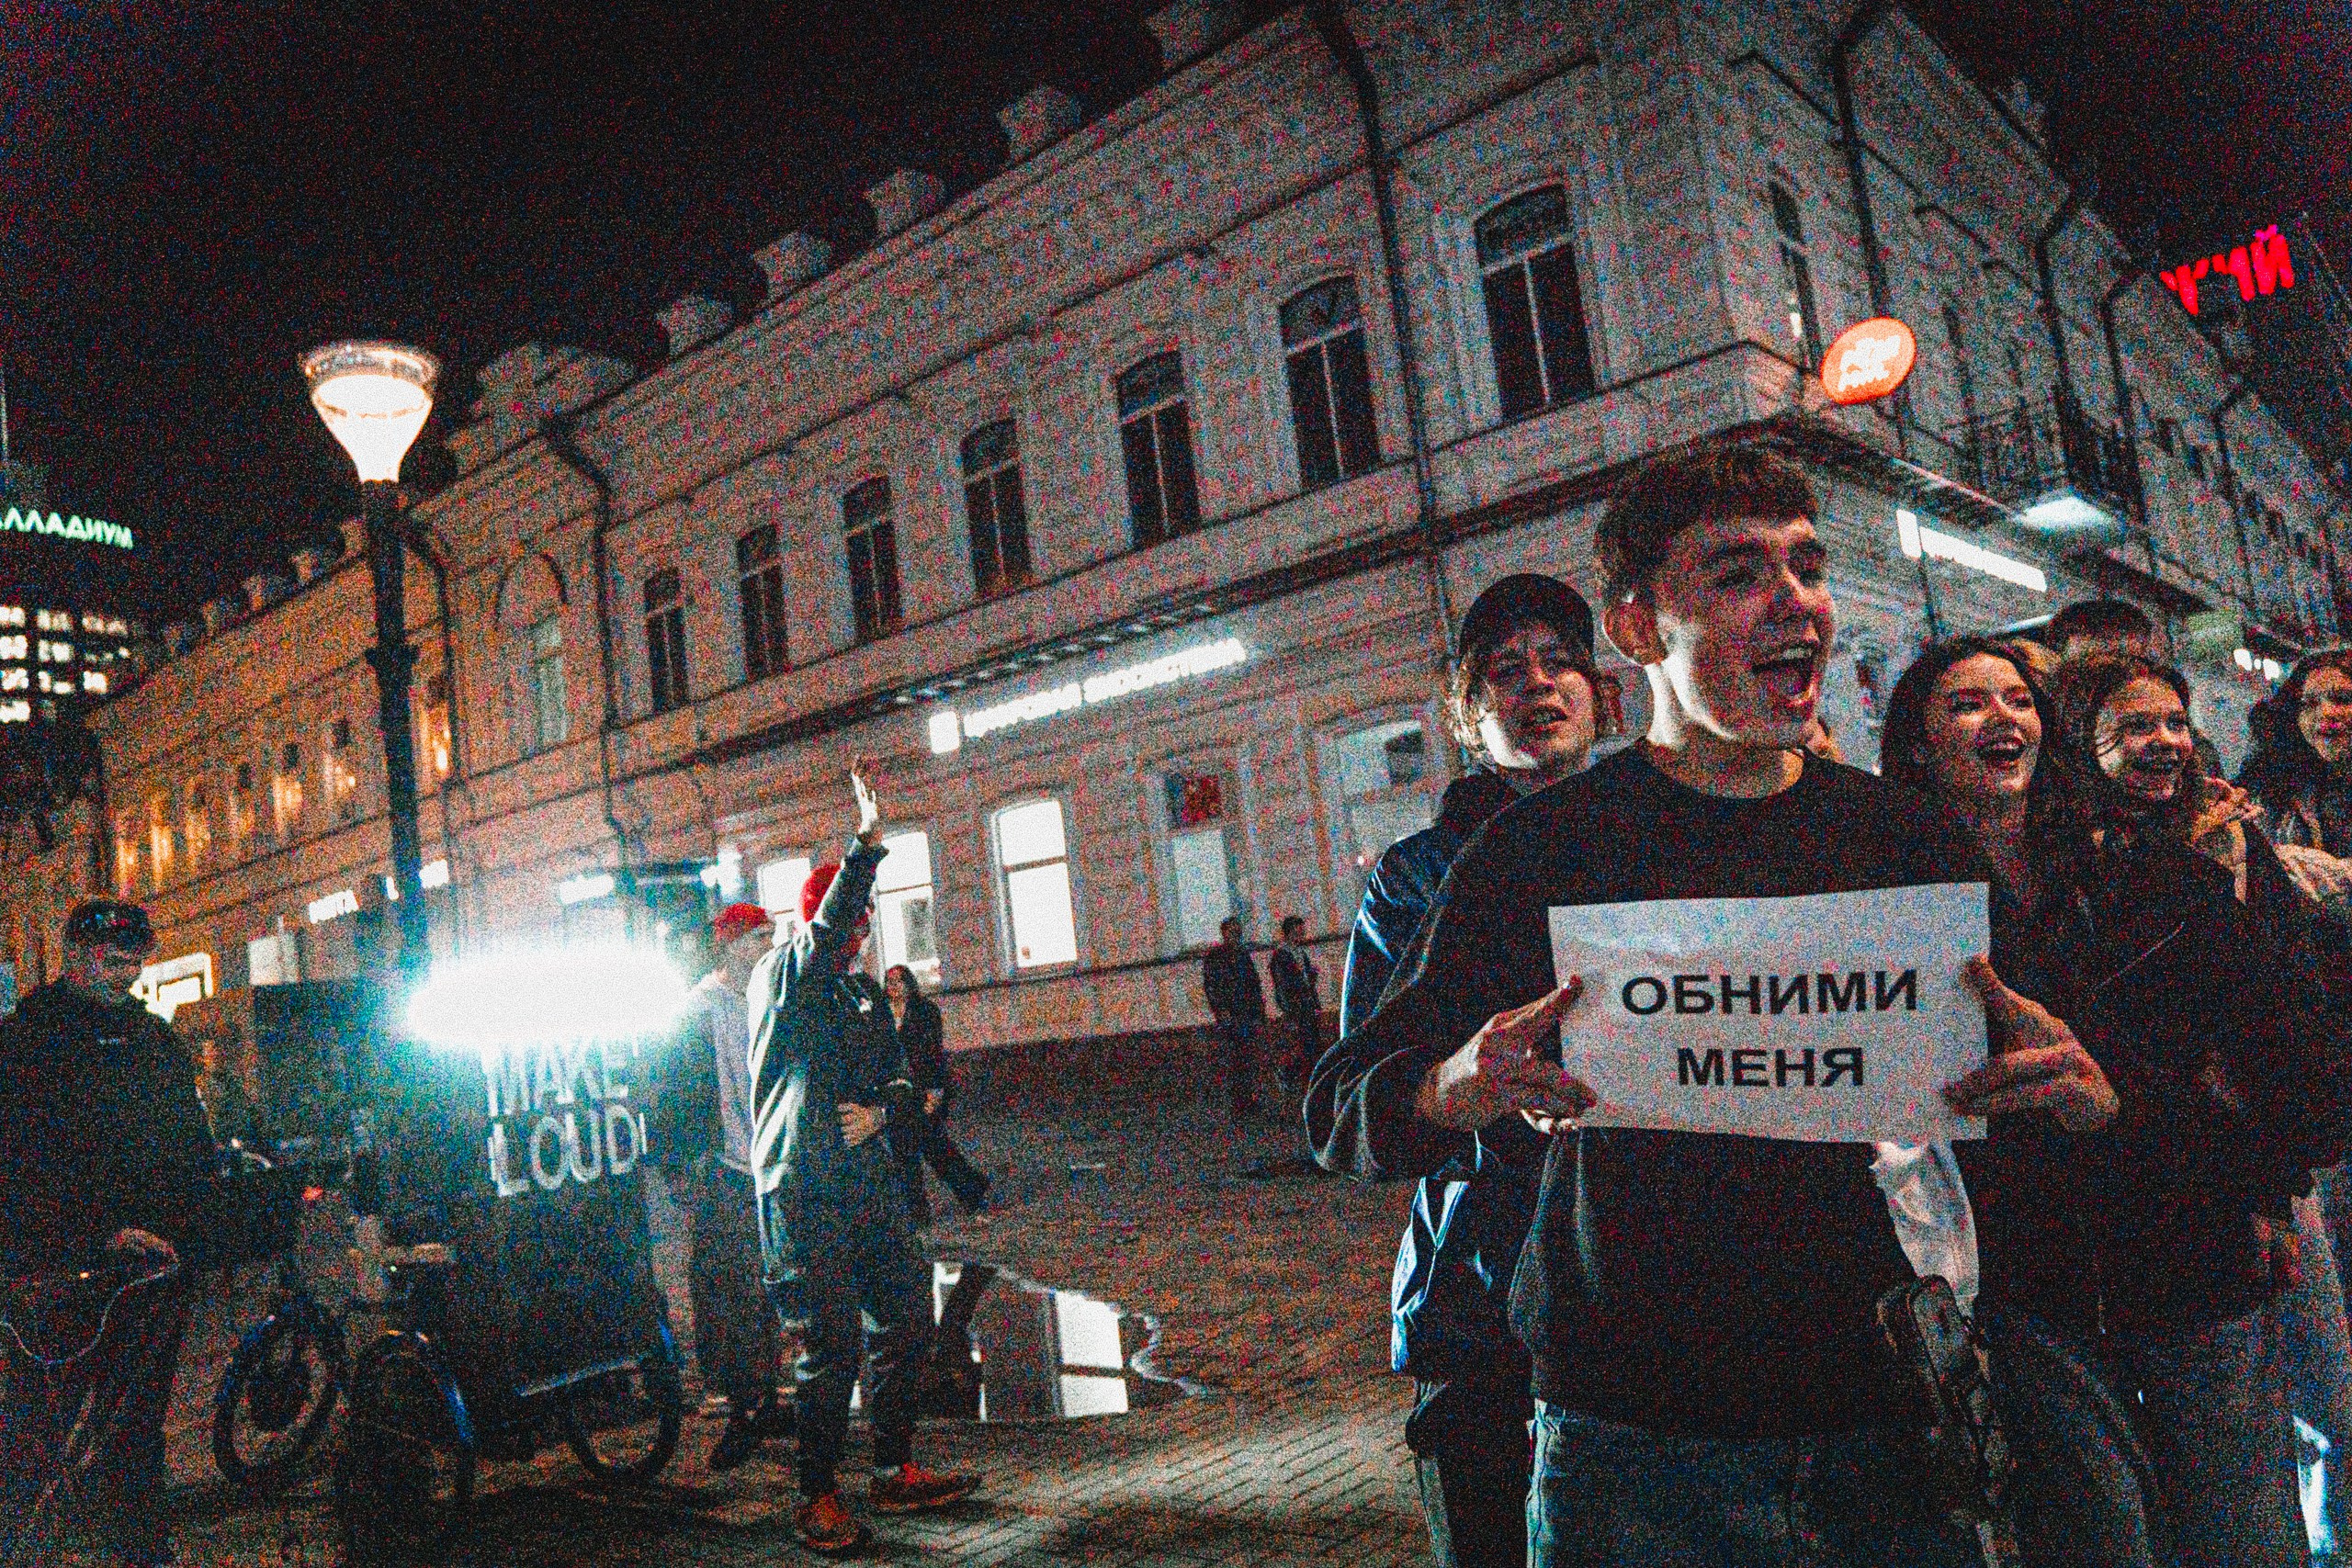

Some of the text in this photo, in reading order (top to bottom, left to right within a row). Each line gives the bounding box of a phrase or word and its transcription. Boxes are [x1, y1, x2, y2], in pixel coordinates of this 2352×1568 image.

[0, 506, 133, 549] ЛЛАДИУМ
[1621, 968, 1917, 1015] ОБНИМИ
[1677, 1047, 1864, 1088] МЕНЯ
